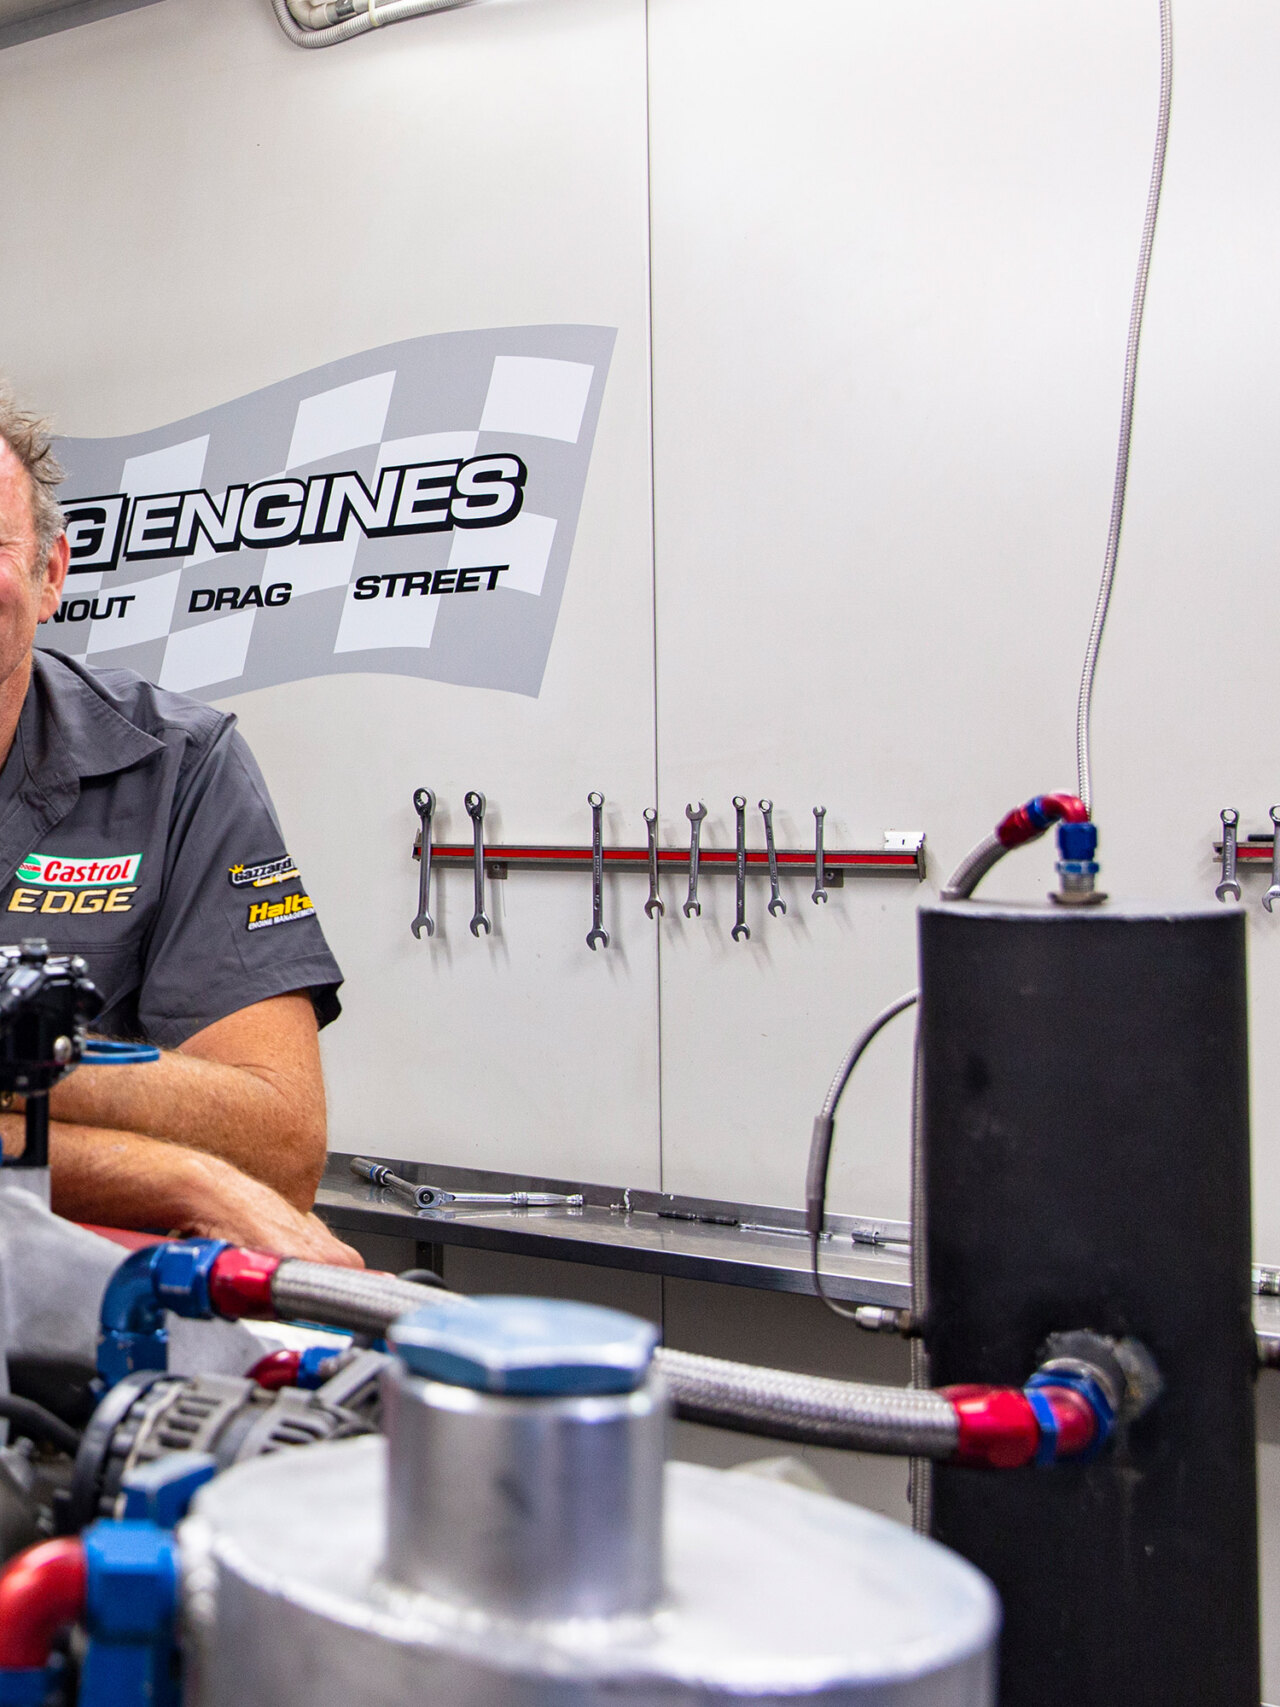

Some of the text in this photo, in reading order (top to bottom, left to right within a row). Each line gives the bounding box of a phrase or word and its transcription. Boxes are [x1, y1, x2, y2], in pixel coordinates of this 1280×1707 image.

[124, 453, 528, 561] ENGINES
[44, 564, 510, 624] NOUT DRAG STREET
[43, 859, 131, 882] Castrol
[7, 886, 139, 914] EDGE
[249, 894, 314, 923] Halte
[274, 907, 315, 924] MANAGEMEN
